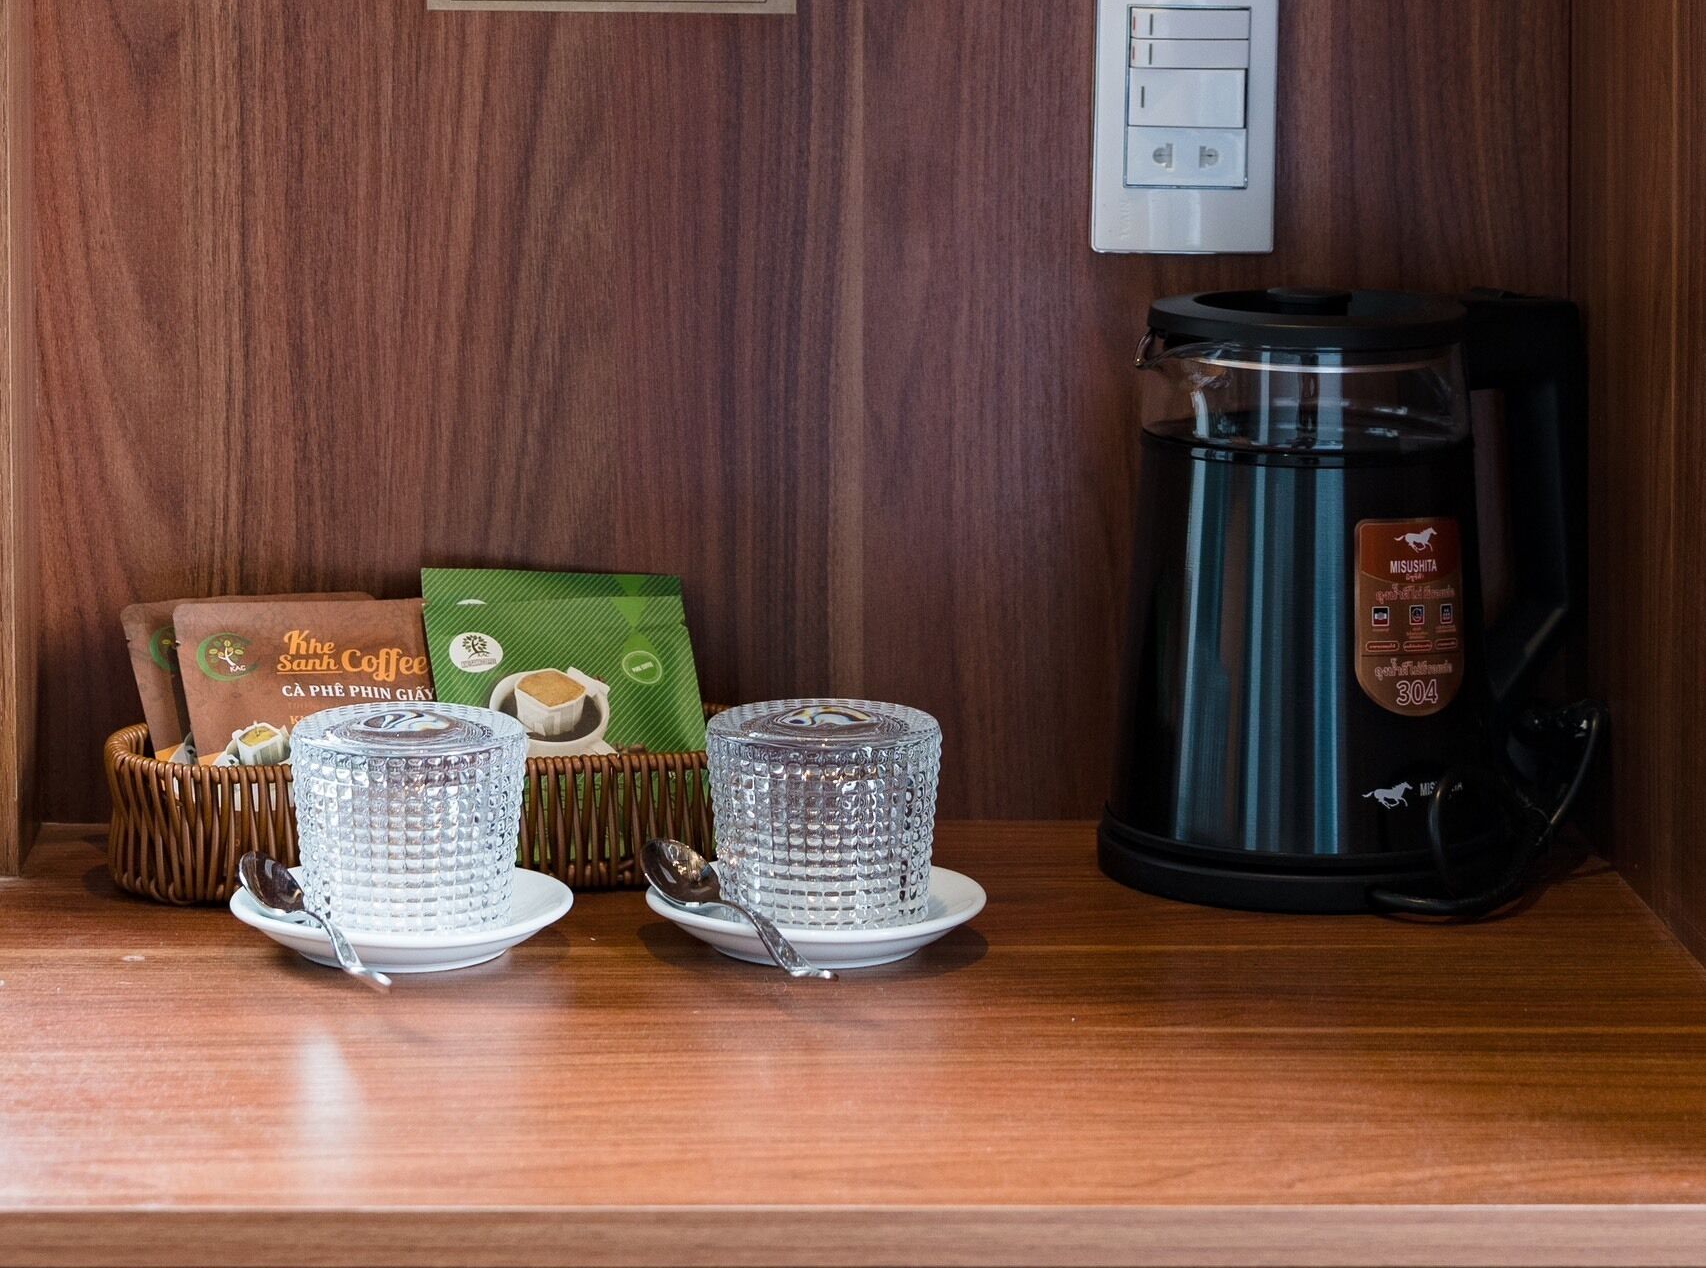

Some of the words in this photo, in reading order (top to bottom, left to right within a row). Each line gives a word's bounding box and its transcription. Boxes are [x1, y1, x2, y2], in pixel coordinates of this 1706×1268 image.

[1390, 558, 1438, 574] MISUSHITA
[283, 630, 336, 656] Khe
[277, 654, 342, 672] Sanh
[341, 647, 429, 682] Coffee
[282, 682, 305, 698] CÀ
[310, 683, 344, 698] PHÊ
[349, 685, 392, 700] PHIN
[396, 684, 434, 701] GIẤY
[1396, 678, 1439, 706] 304
